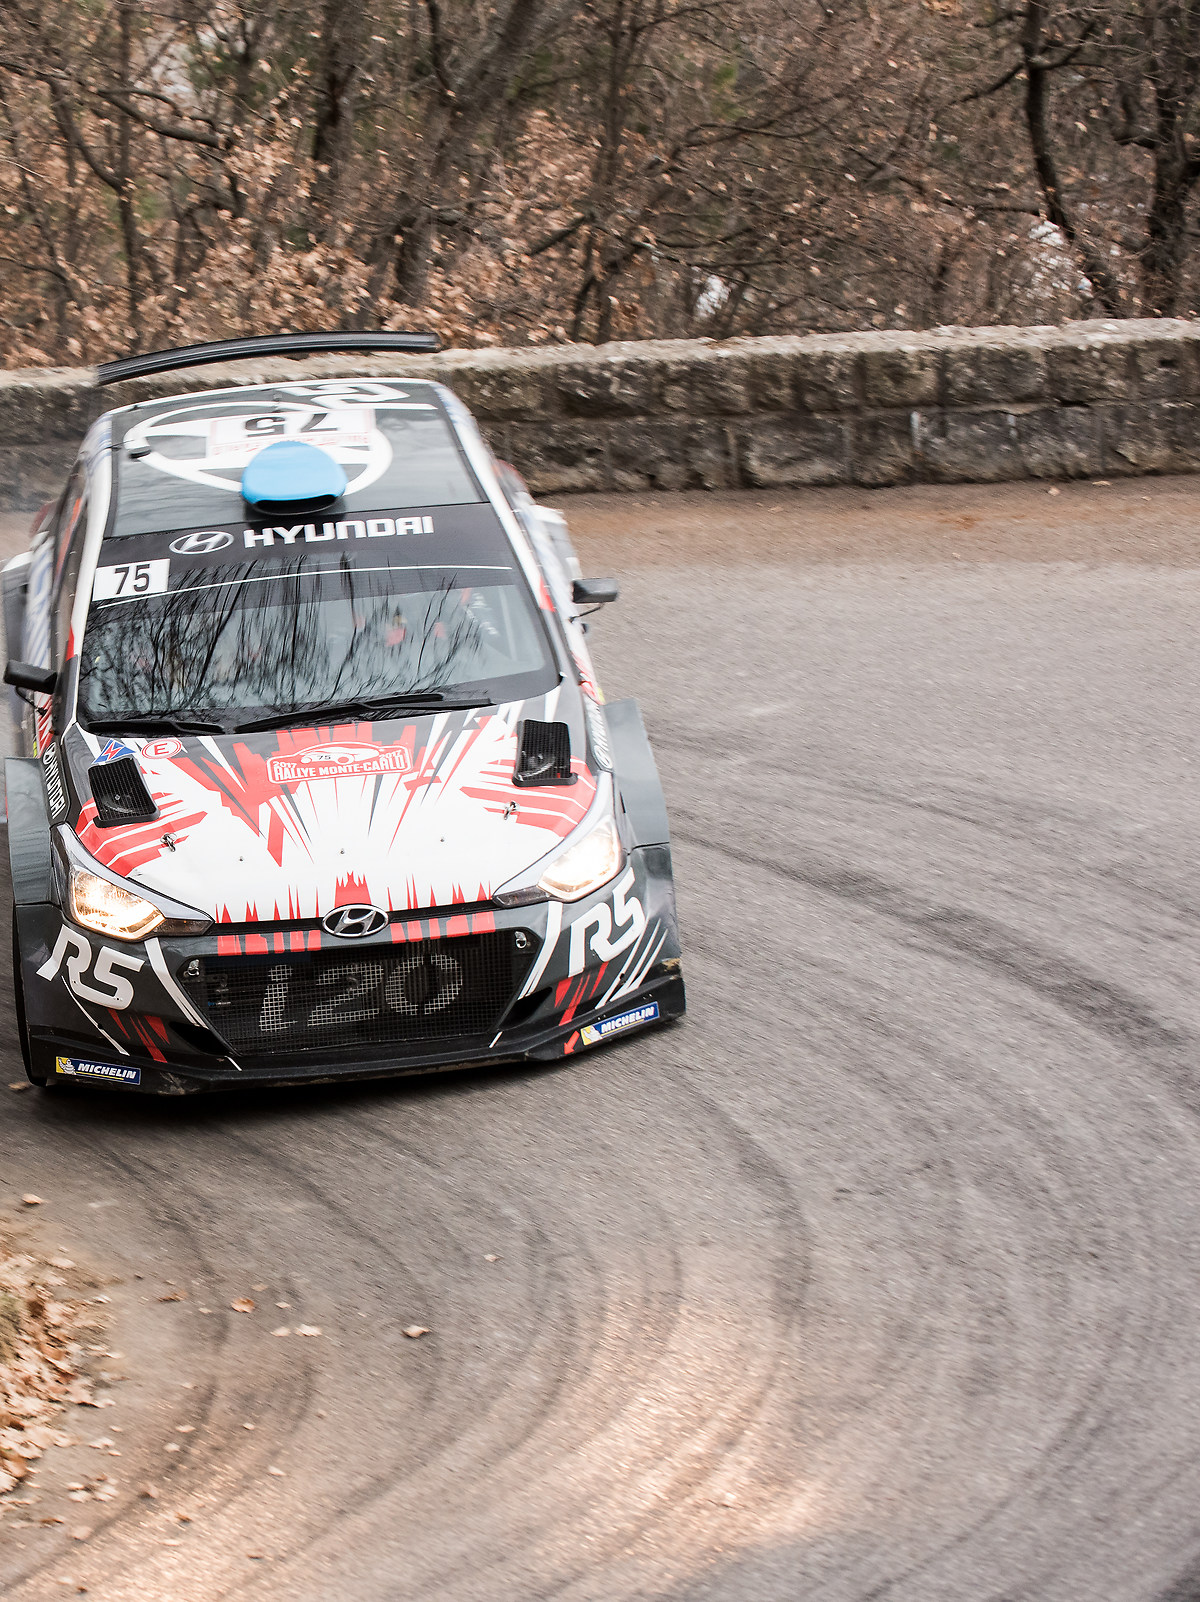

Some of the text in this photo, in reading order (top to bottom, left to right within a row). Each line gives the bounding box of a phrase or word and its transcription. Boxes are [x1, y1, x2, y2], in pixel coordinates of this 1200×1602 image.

[244, 413, 330, 436] 75
[243, 515, 435, 549] HYUNDAI
[114, 563, 151, 595] 75
[153, 742, 170, 756] E
[272, 760, 297, 769] 2017
[274, 754, 406, 781] RALLYE MONTE-CARLO
[568, 866, 646, 978] R5
[36, 924, 145, 1010] R5
[601, 1005, 655, 1034] MICHELIN
[77, 1062, 137, 1080] MICHELIN
